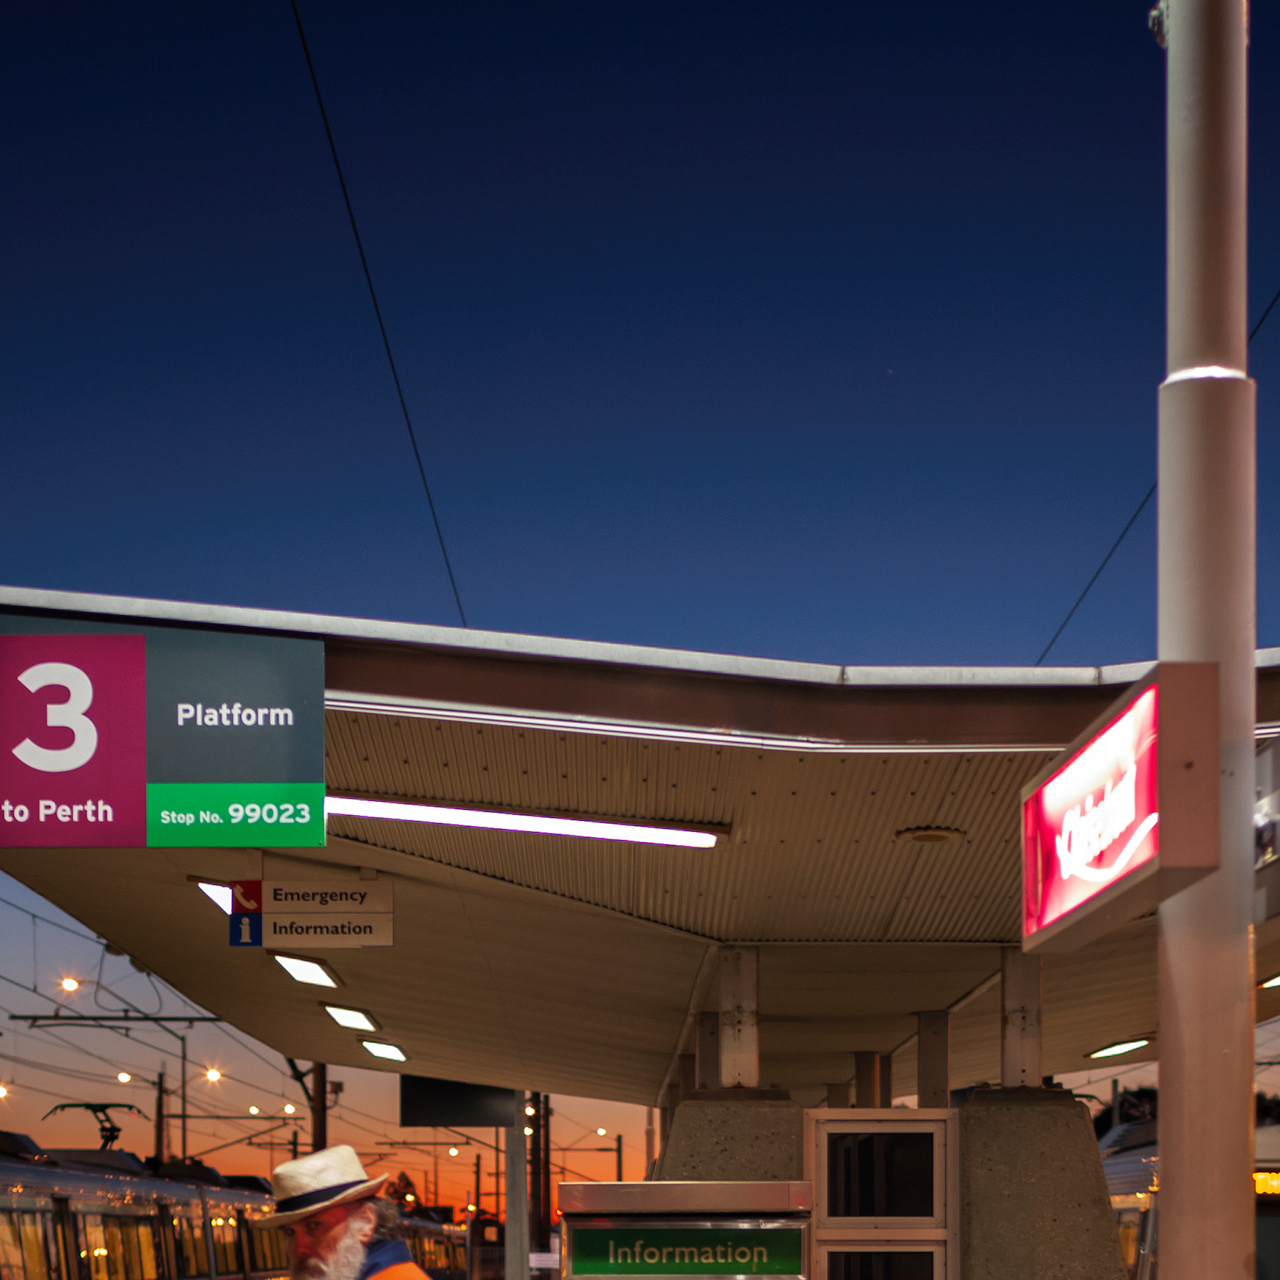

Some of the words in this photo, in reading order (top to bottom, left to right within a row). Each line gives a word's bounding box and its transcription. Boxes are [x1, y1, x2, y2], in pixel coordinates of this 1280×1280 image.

[11, 661, 98, 772] 3
[177, 702, 294, 726] Platform
[1, 800, 29, 823] to
[39, 799, 113, 822] Perth
[160, 810, 195, 826] Stop
[199, 810, 224, 824] No.
[228, 803, 311, 824] 99023
[272, 888, 368, 905] Emergency
[272, 921, 373, 935] Information
[607, 1239, 769, 1265] Information
